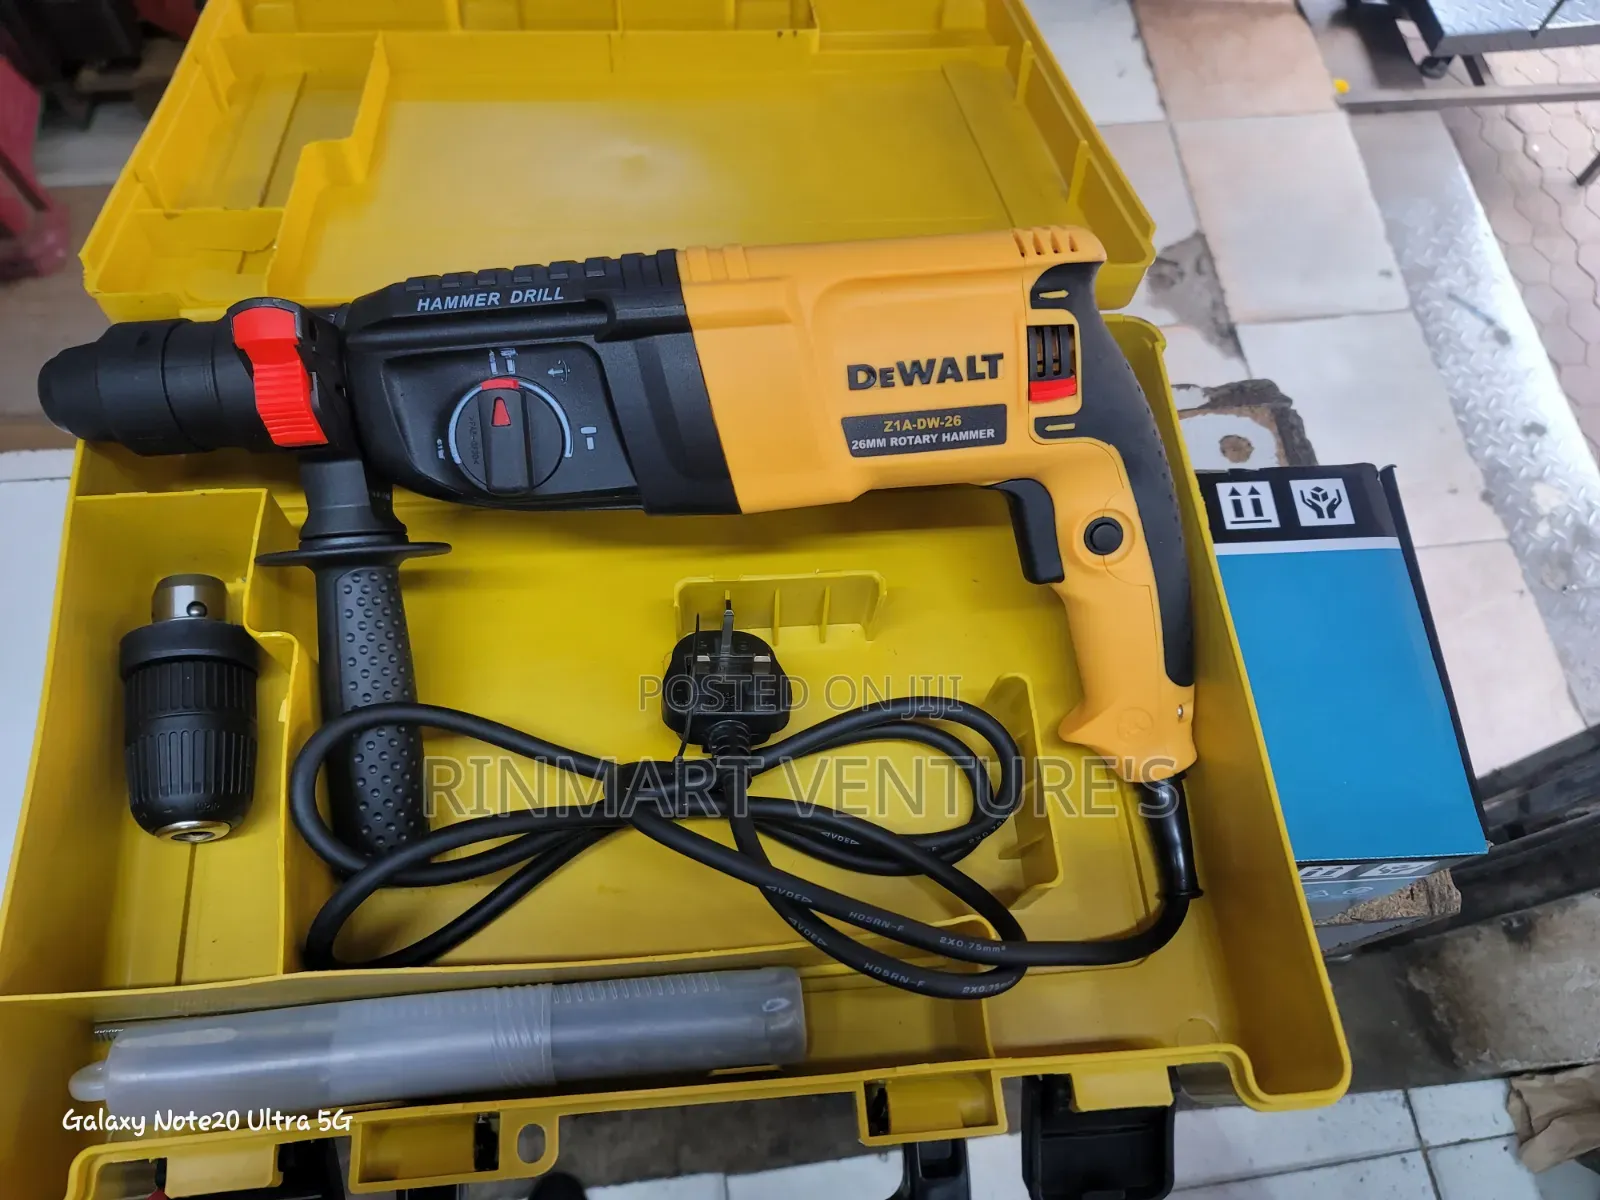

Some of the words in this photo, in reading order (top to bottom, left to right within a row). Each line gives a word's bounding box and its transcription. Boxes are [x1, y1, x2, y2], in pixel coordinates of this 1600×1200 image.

[417, 292, 501, 312] HAMMER
[509, 286, 565, 305] DRILL
[883, 415, 962, 433] Z1A-DW-26
[851, 437, 887, 451] 26MM
[890, 433, 939, 447] ROTARY
[941, 428, 995, 443] HAMMER
